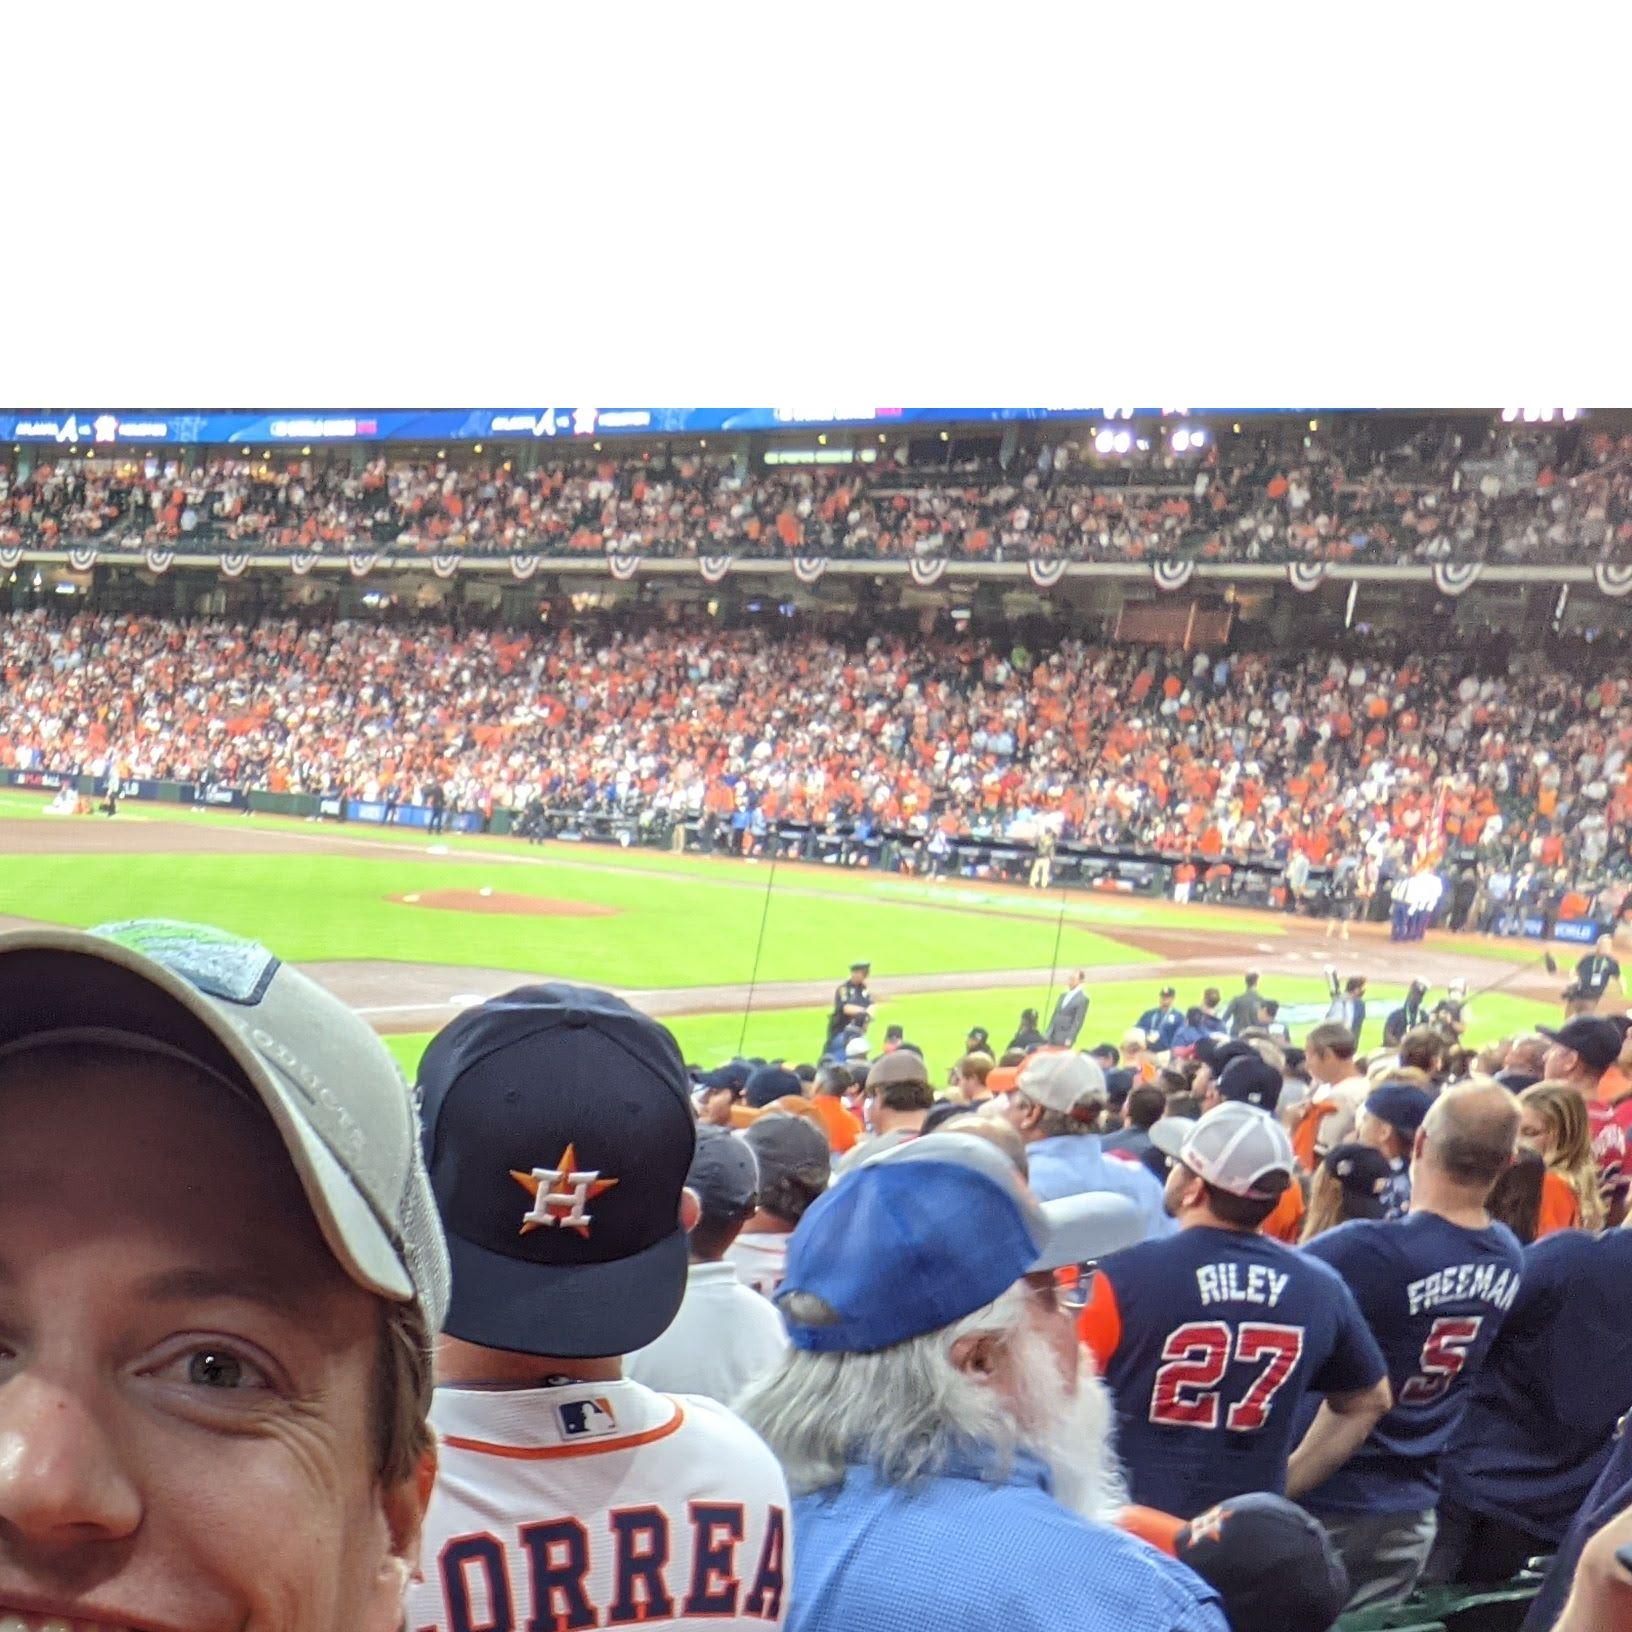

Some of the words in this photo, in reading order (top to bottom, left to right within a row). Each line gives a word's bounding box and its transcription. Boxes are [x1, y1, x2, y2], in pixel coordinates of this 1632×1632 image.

[1195, 1262, 1291, 1308] RILEY
[1406, 1263, 1520, 1317] FREEMAN
[1149, 1320, 1307, 1432] 27
[1398, 1316, 1484, 1406] 5
